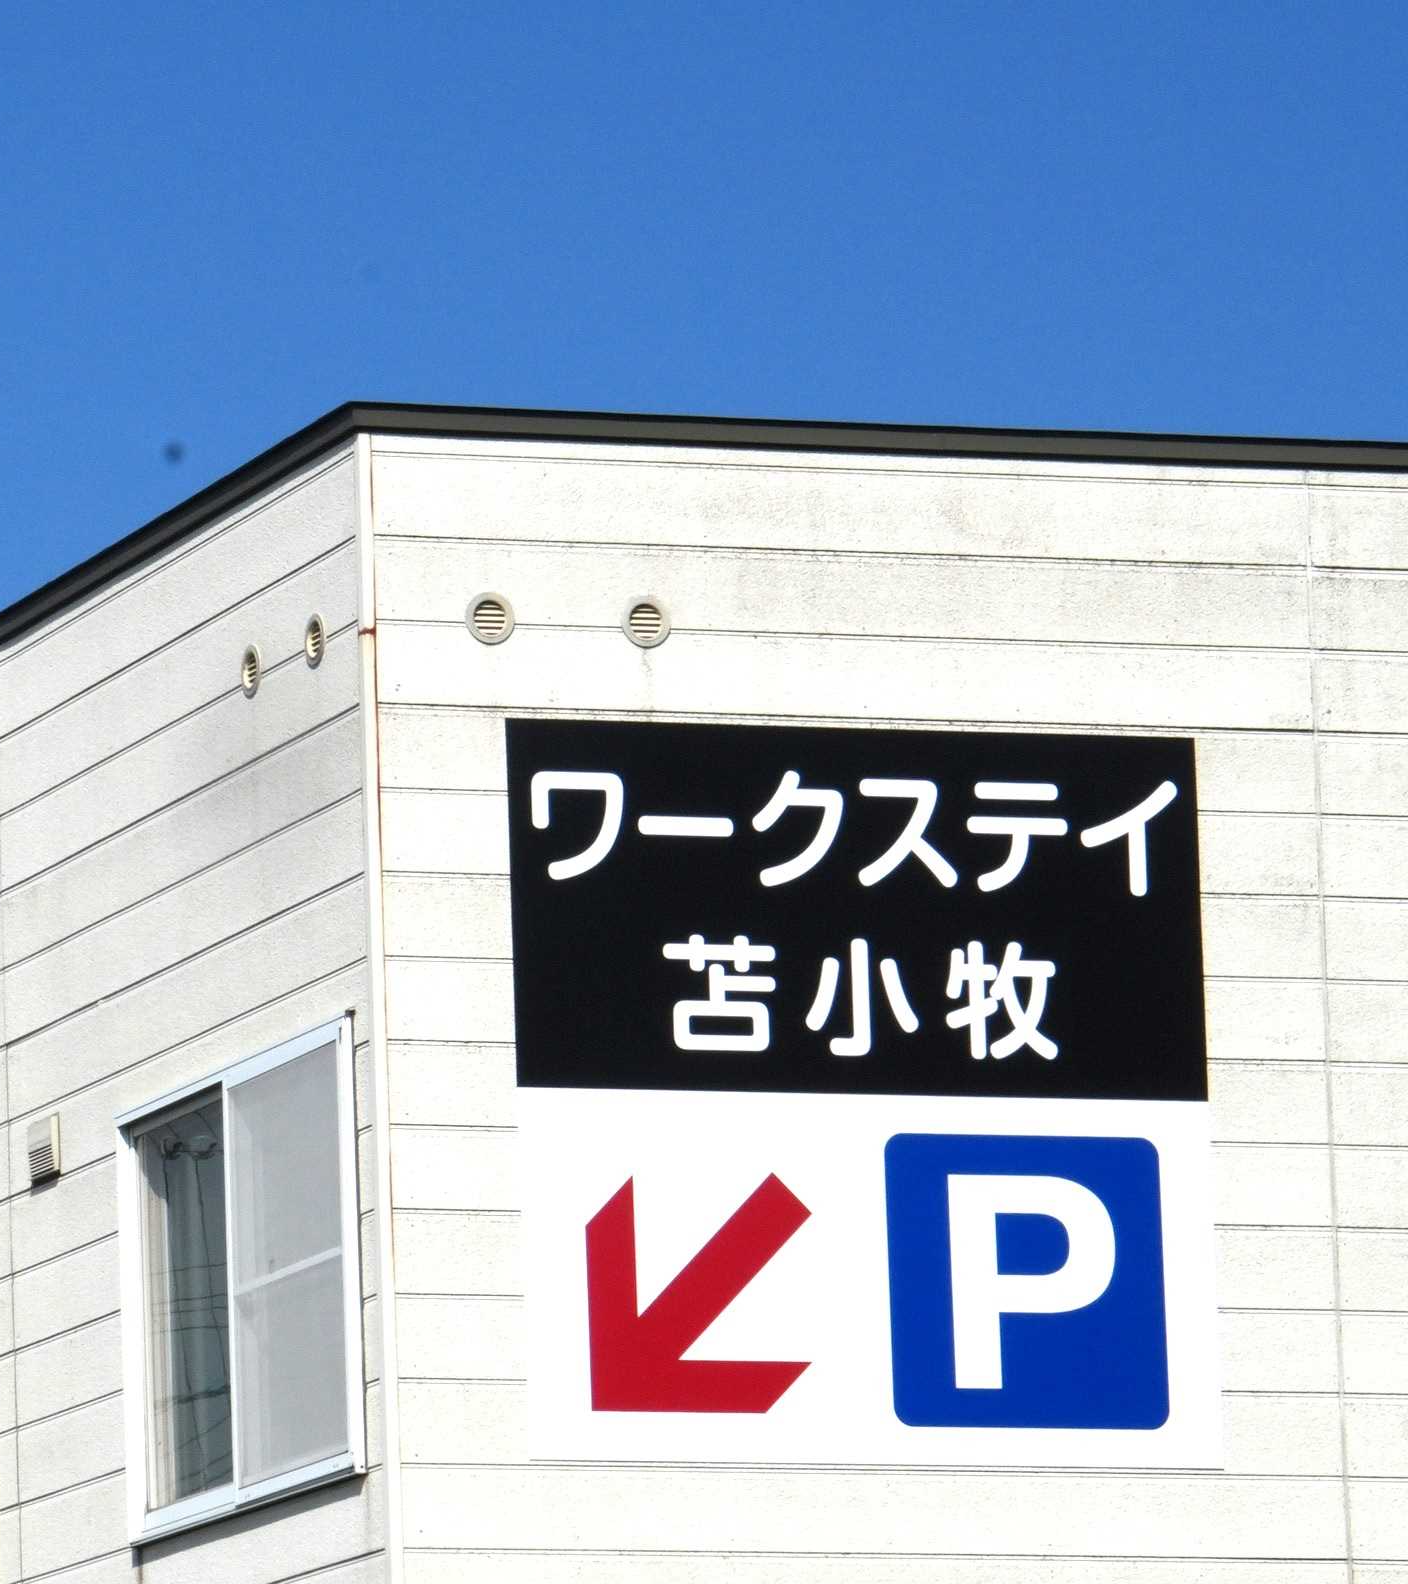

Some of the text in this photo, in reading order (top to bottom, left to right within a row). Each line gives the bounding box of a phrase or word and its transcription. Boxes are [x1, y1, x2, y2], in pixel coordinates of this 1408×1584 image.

[531, 770, 1177, 896] ワークステイ
[662, 934, 1059, 1060] 苫小牧
[947, 1174, 1116, 1390] P
